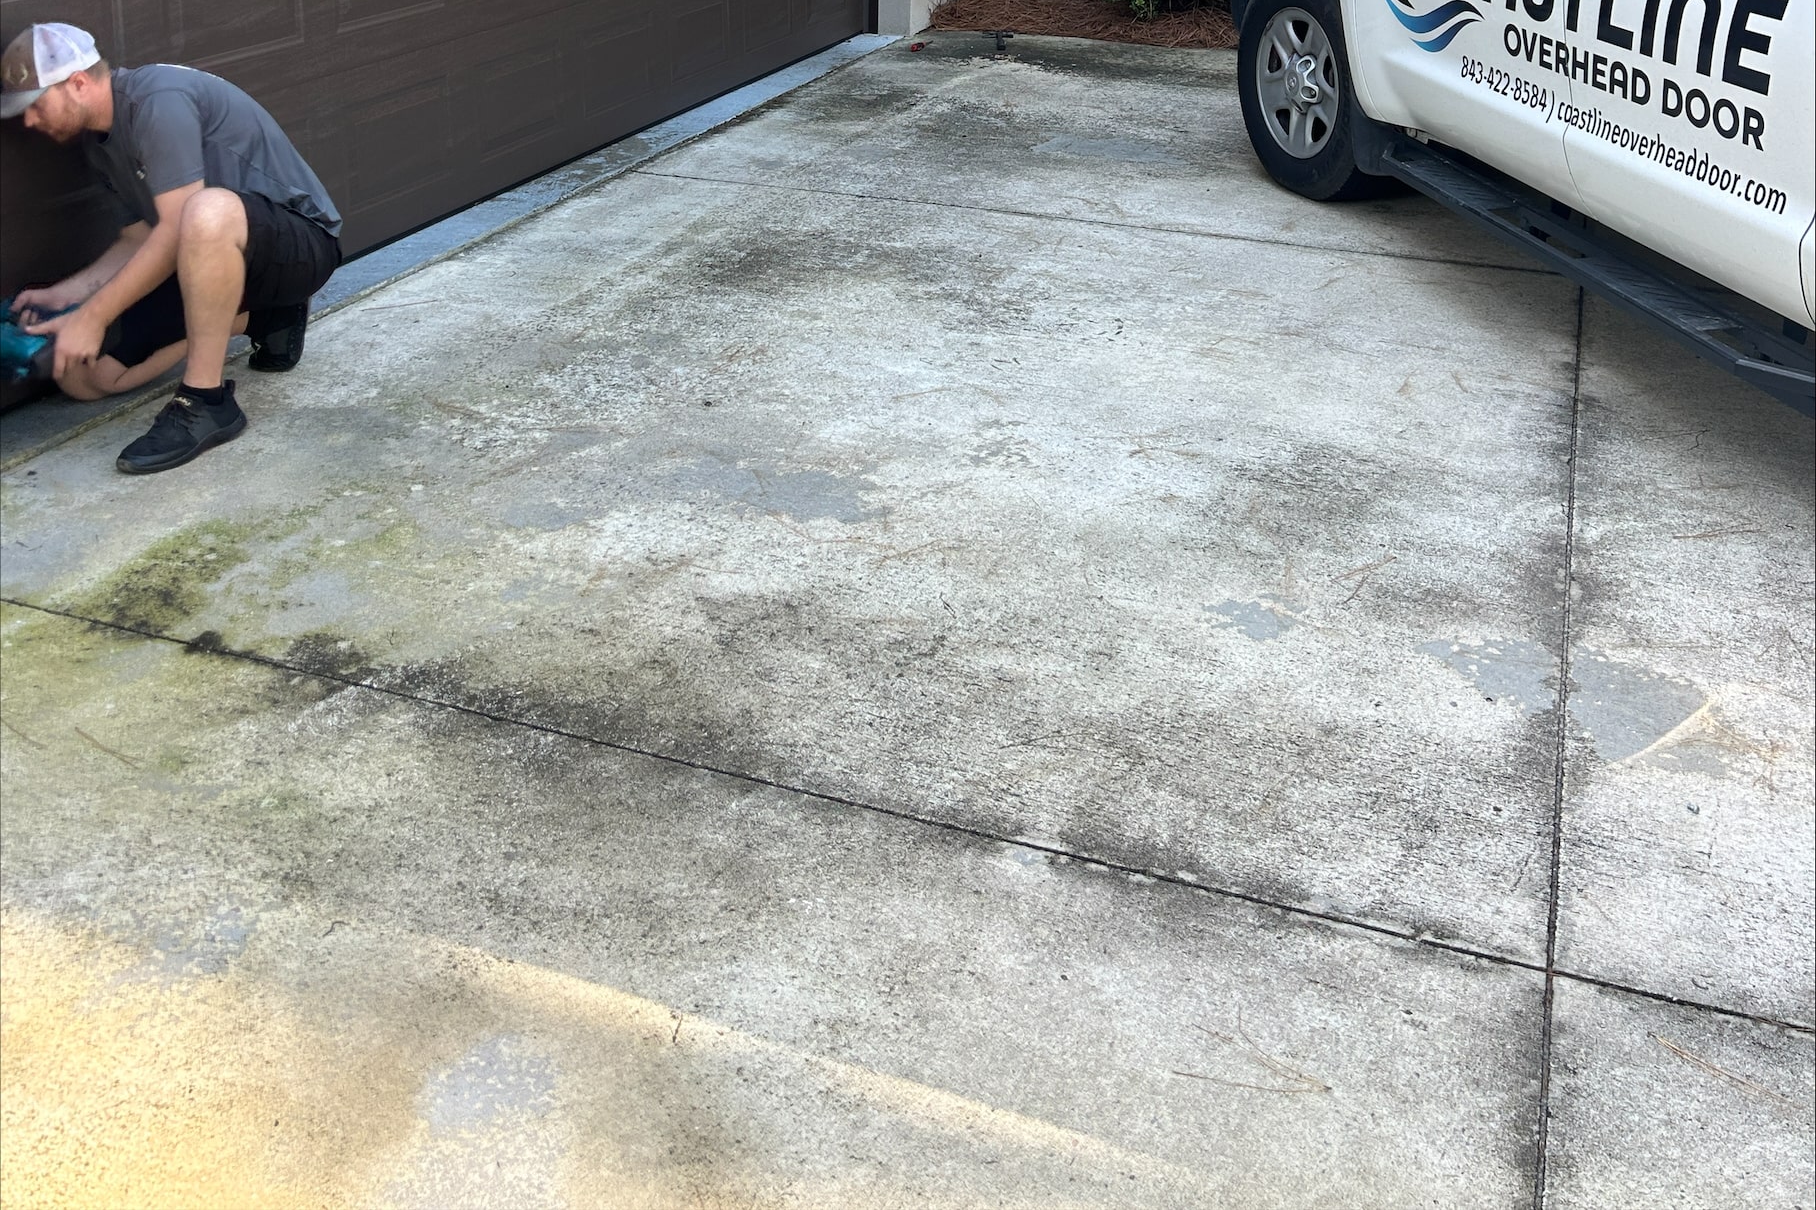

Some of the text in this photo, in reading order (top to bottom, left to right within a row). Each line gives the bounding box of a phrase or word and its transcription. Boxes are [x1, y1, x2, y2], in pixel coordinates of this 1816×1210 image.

[1503, 23, 1765, 151] OVERHEAD DOOR
[1557, 101, 1787, 215] coastlineoverheaddoor.com
